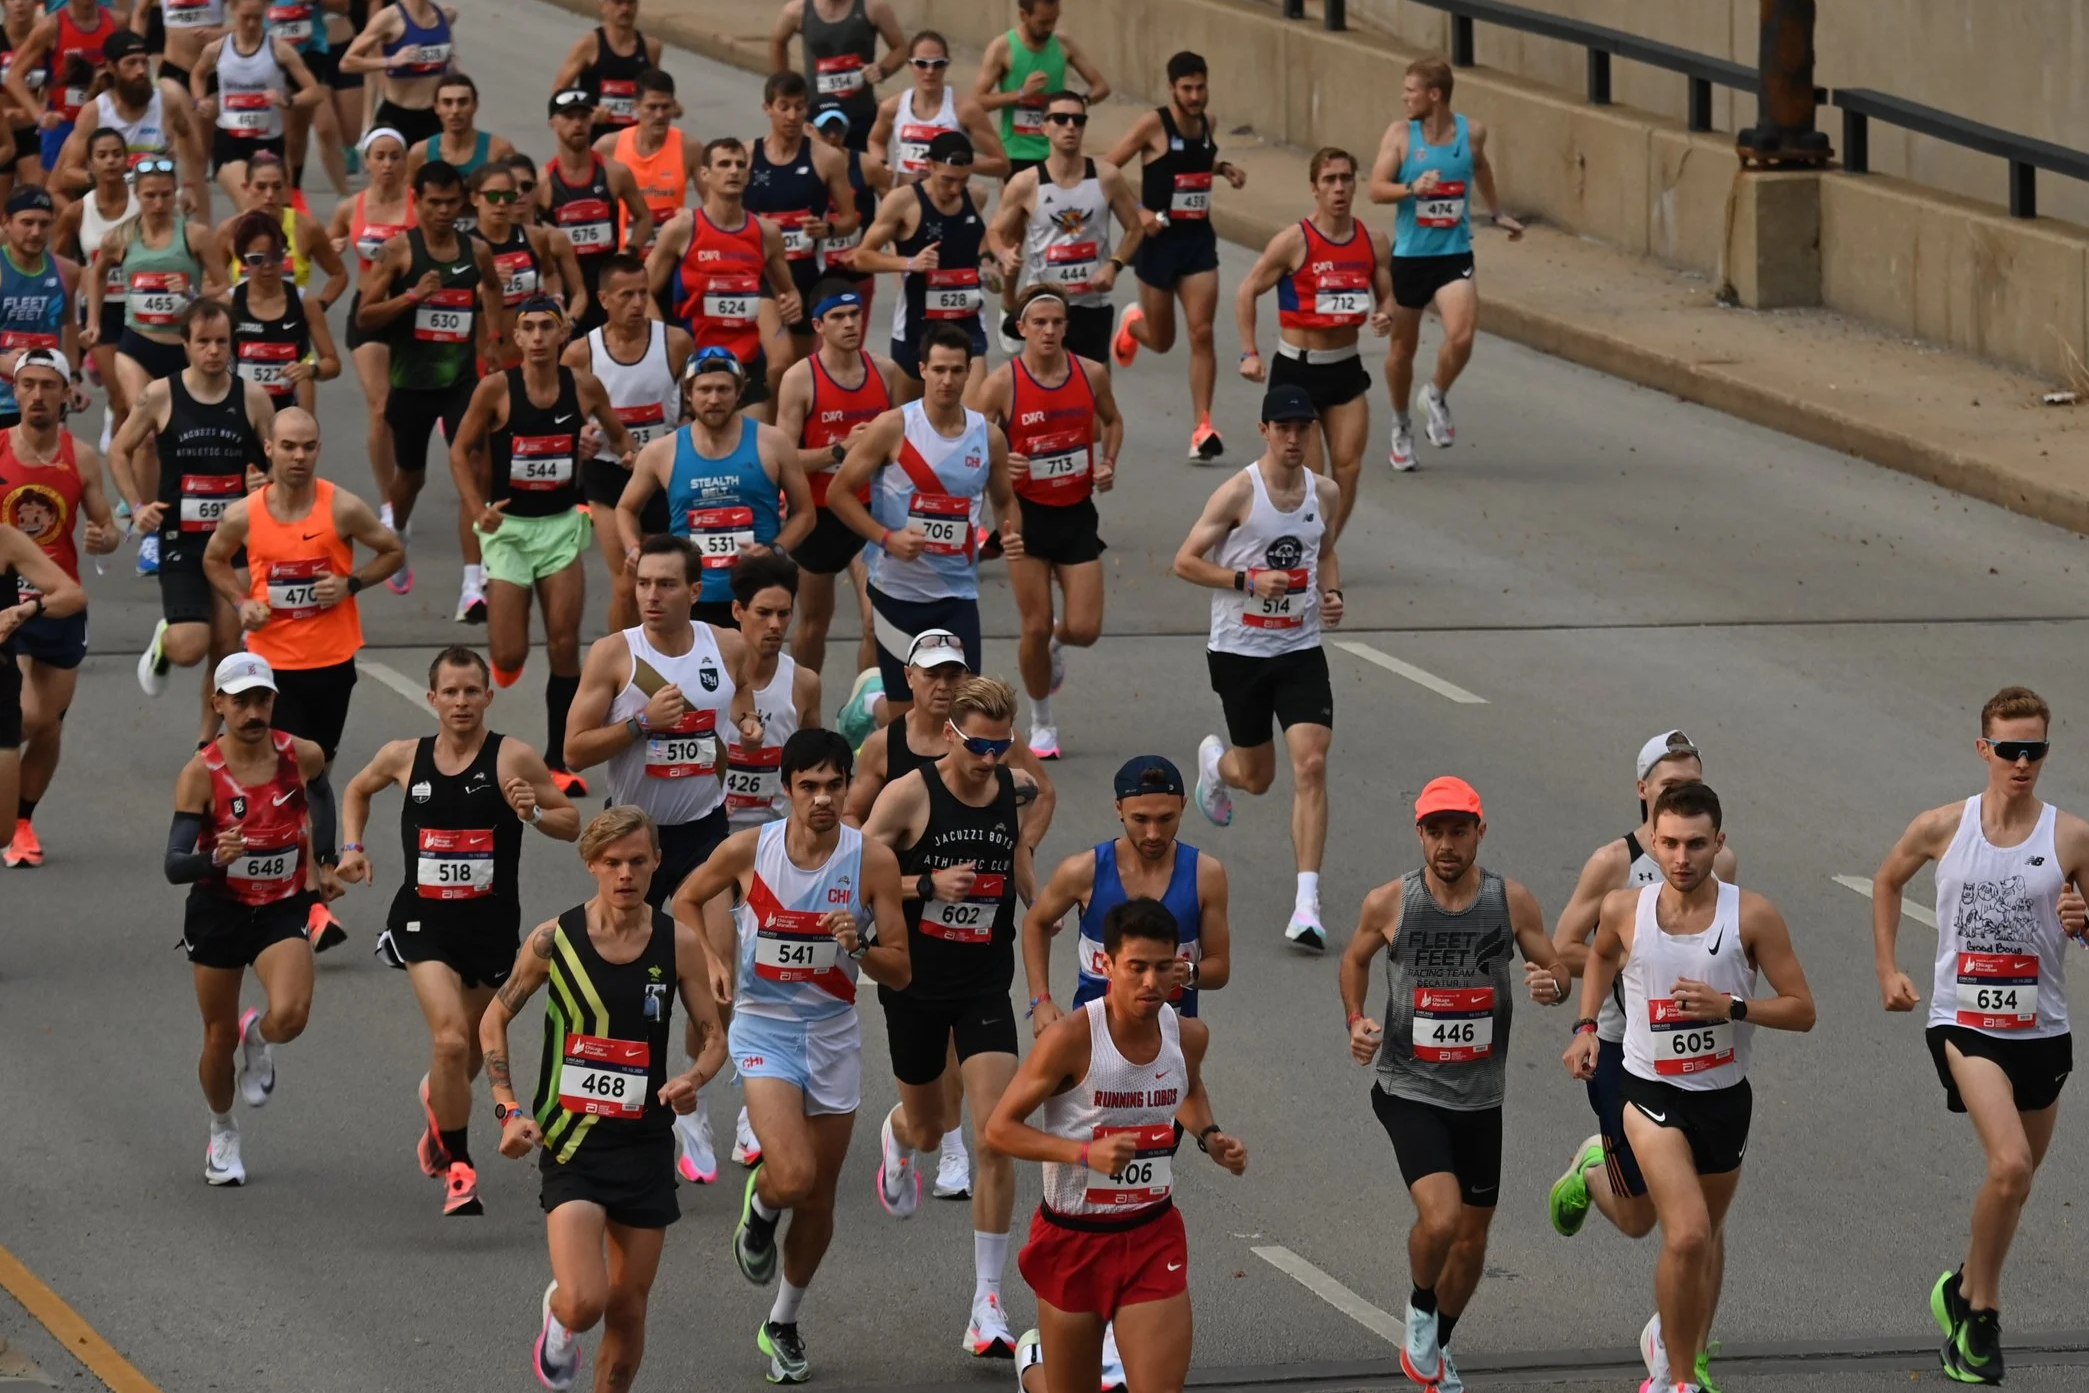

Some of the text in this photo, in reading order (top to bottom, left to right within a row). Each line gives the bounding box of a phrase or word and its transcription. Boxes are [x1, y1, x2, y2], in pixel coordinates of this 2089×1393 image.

[1428, 202, 1453, 215] 474
[572, 227, 599, 241] 676
[1060, 266, 1087, 280] 444
[504, 277, 523, 292] 26
[3, 296, 49, 310] FLEET
[144, 297, 173, 311] 465
[718, 300, 746, 314] 624
[940, 294, 967, 308] 628
[1332, 297, 1355, 310] 712
[7, 309, 43, 321] FEET
[430, 313, 458, 328] 630
[526, 462, 557, 478] 544
[1048, 457, 1073, 474] 713
[690, 475, 740, 489] STEALTH
[701, 487, 728, 498] BELT
[924, 522, 954, 540] 706
[708, 537, 735, 552] 531
[1263, 598, 1290, 614] 514
[667, 742, 698, 762] 510
[728, 774, 760, 793] 426
[935, 830, 1013, 850] JACUZZI BOYS
[247, 858, 284, 876] 648
[439, 864, 471, 882] 518
[828, 889, 850, 904] CHI
[942, 905, 980, 924] 602
[1408, 931, 1477, 949] FLEET
[1967, 941, 1993, 953] Good
[778, 944, 814, 964] 541
[1415, 949, 1470, 966] FEET
[1408, 969, 1476, 977] RACING TEAM
[1977, 989, 2018, 1010] 634
[1432, 1023, 1475, 1043] 446
[1672, 1030, 1715, 1055] 605
[582, 1073, 625, 1098] 468
[1094, 1088, 1178, 1108] RUNNING LOBOS
